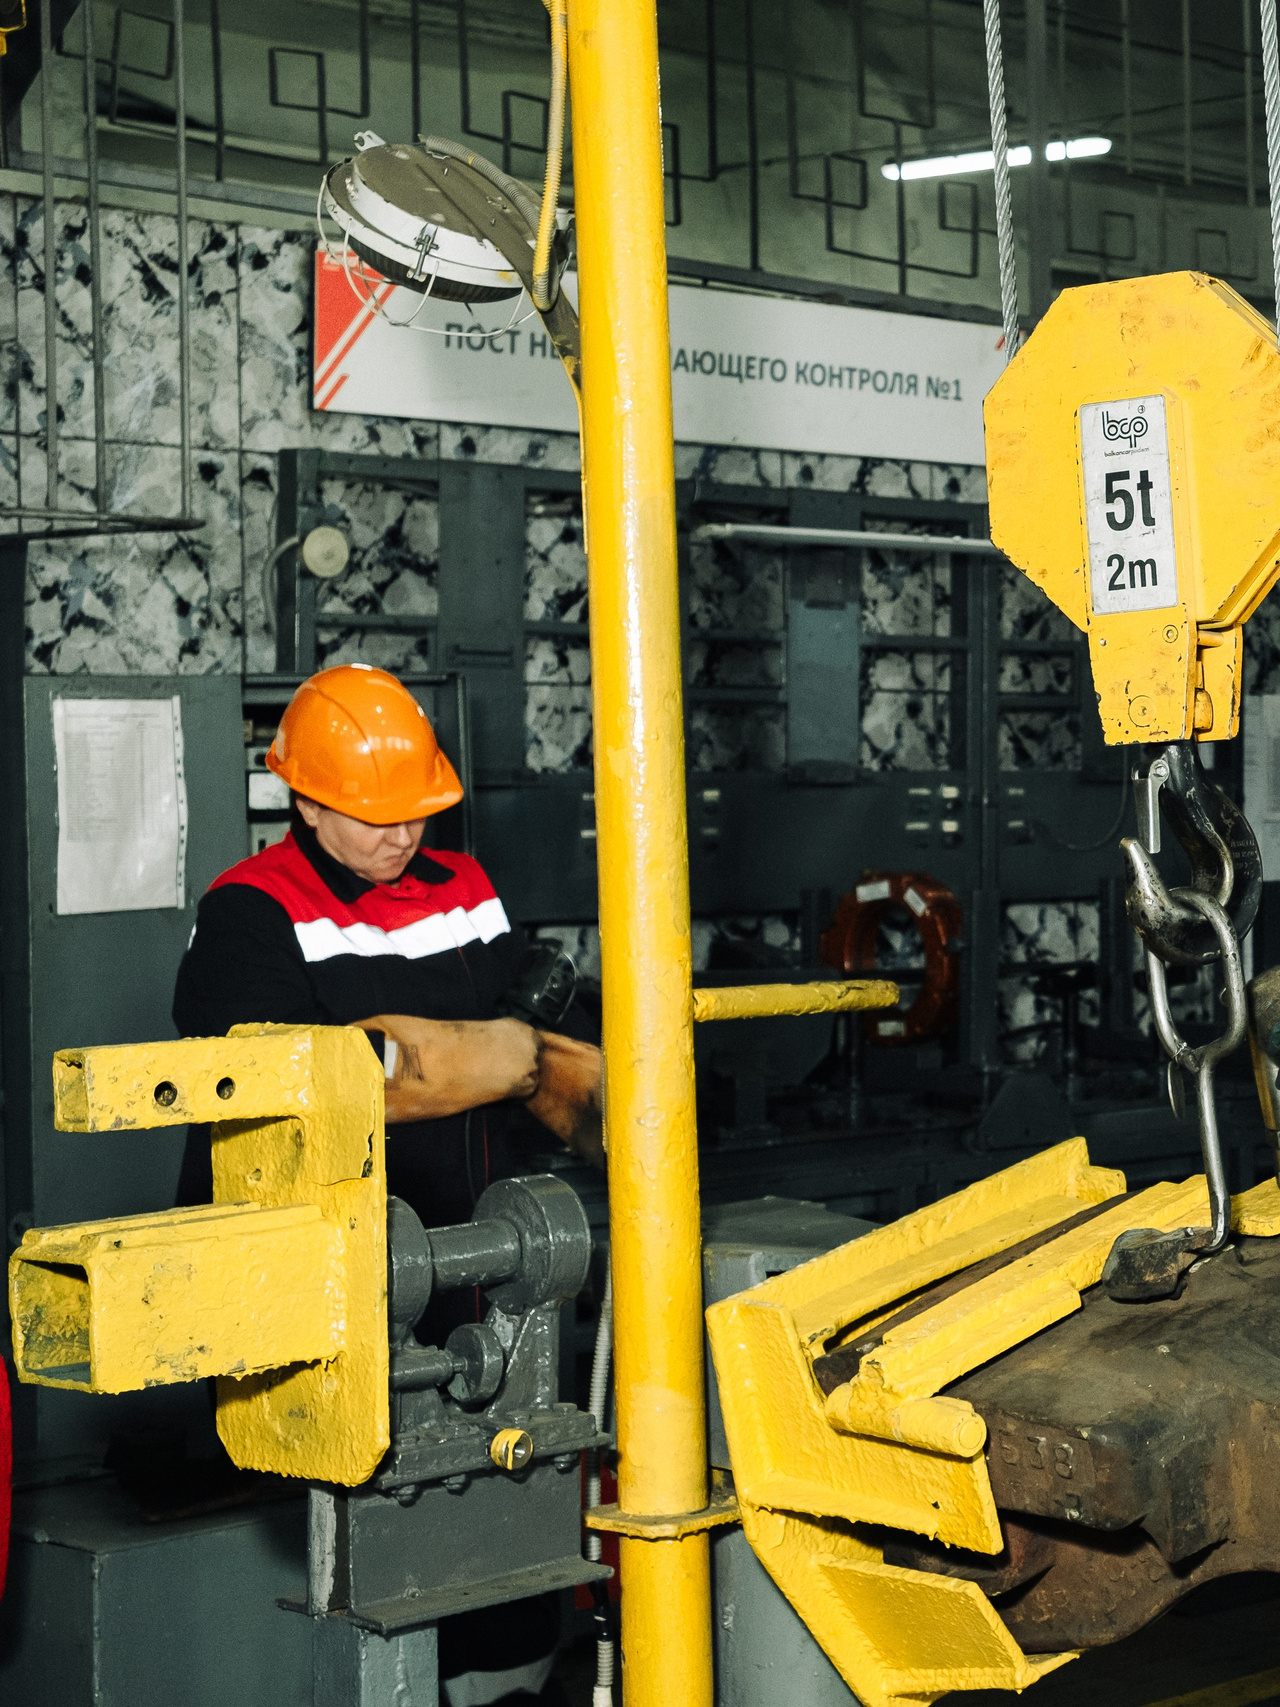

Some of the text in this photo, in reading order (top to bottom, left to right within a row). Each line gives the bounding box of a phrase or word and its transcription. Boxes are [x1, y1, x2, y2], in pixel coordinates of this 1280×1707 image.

[444, 321, 521, 356] ПОСТ
[795, 361, 918, 397] КОНТРОЛЯ
[926, 375, 963, 401] №1
[1105, 469, 1156, 532] 5t
[1106, 553, 1158, 591] 2m
